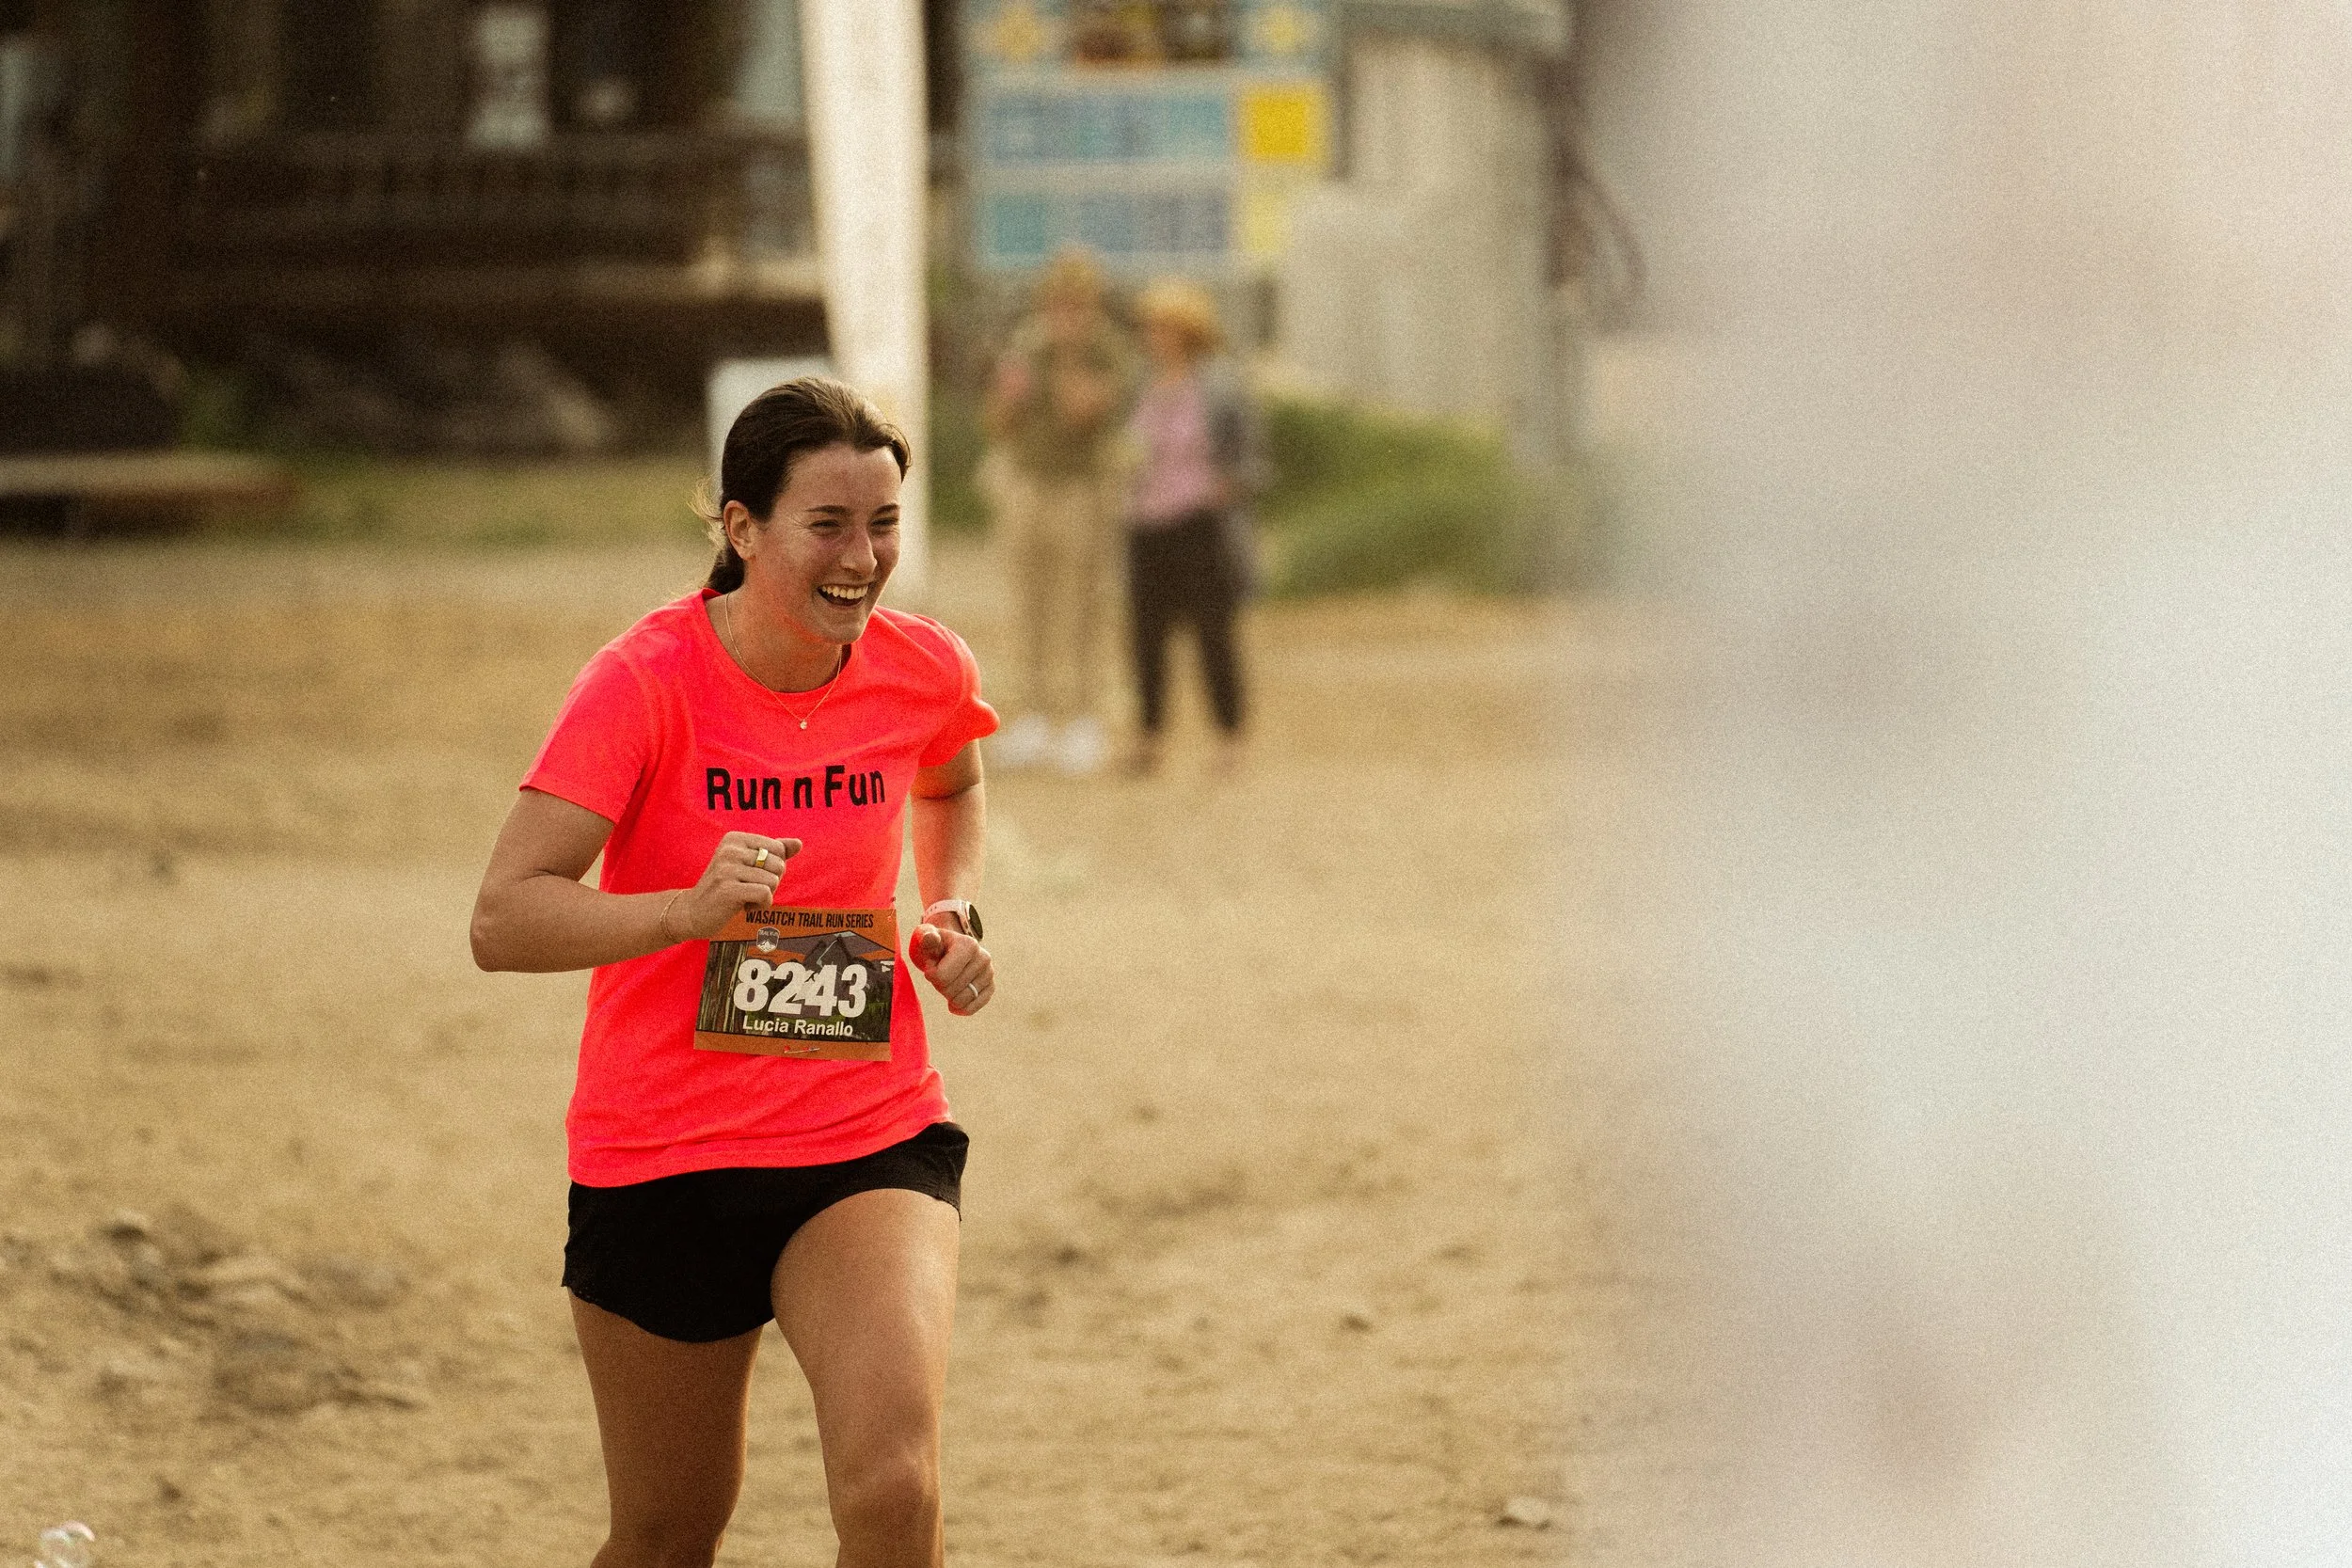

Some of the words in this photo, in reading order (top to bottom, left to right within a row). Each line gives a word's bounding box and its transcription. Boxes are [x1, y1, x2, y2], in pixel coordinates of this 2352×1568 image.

[707, 768, 781, 811] Run
[793, 777, 813, 809] n
[824, 765, 885, 808] Fun
[745, 911, 795, 927] WASATCH
[798, 912, 824, 927] TRAIL
[826, 913, 844, 928] RUN
[845, 914, 874, 928] SERIES
[734, 959, 867, 1018] 8243
[742, 1016, 789, 1033] Lucia
[794, 1019, 853, 1037] Ranallo
